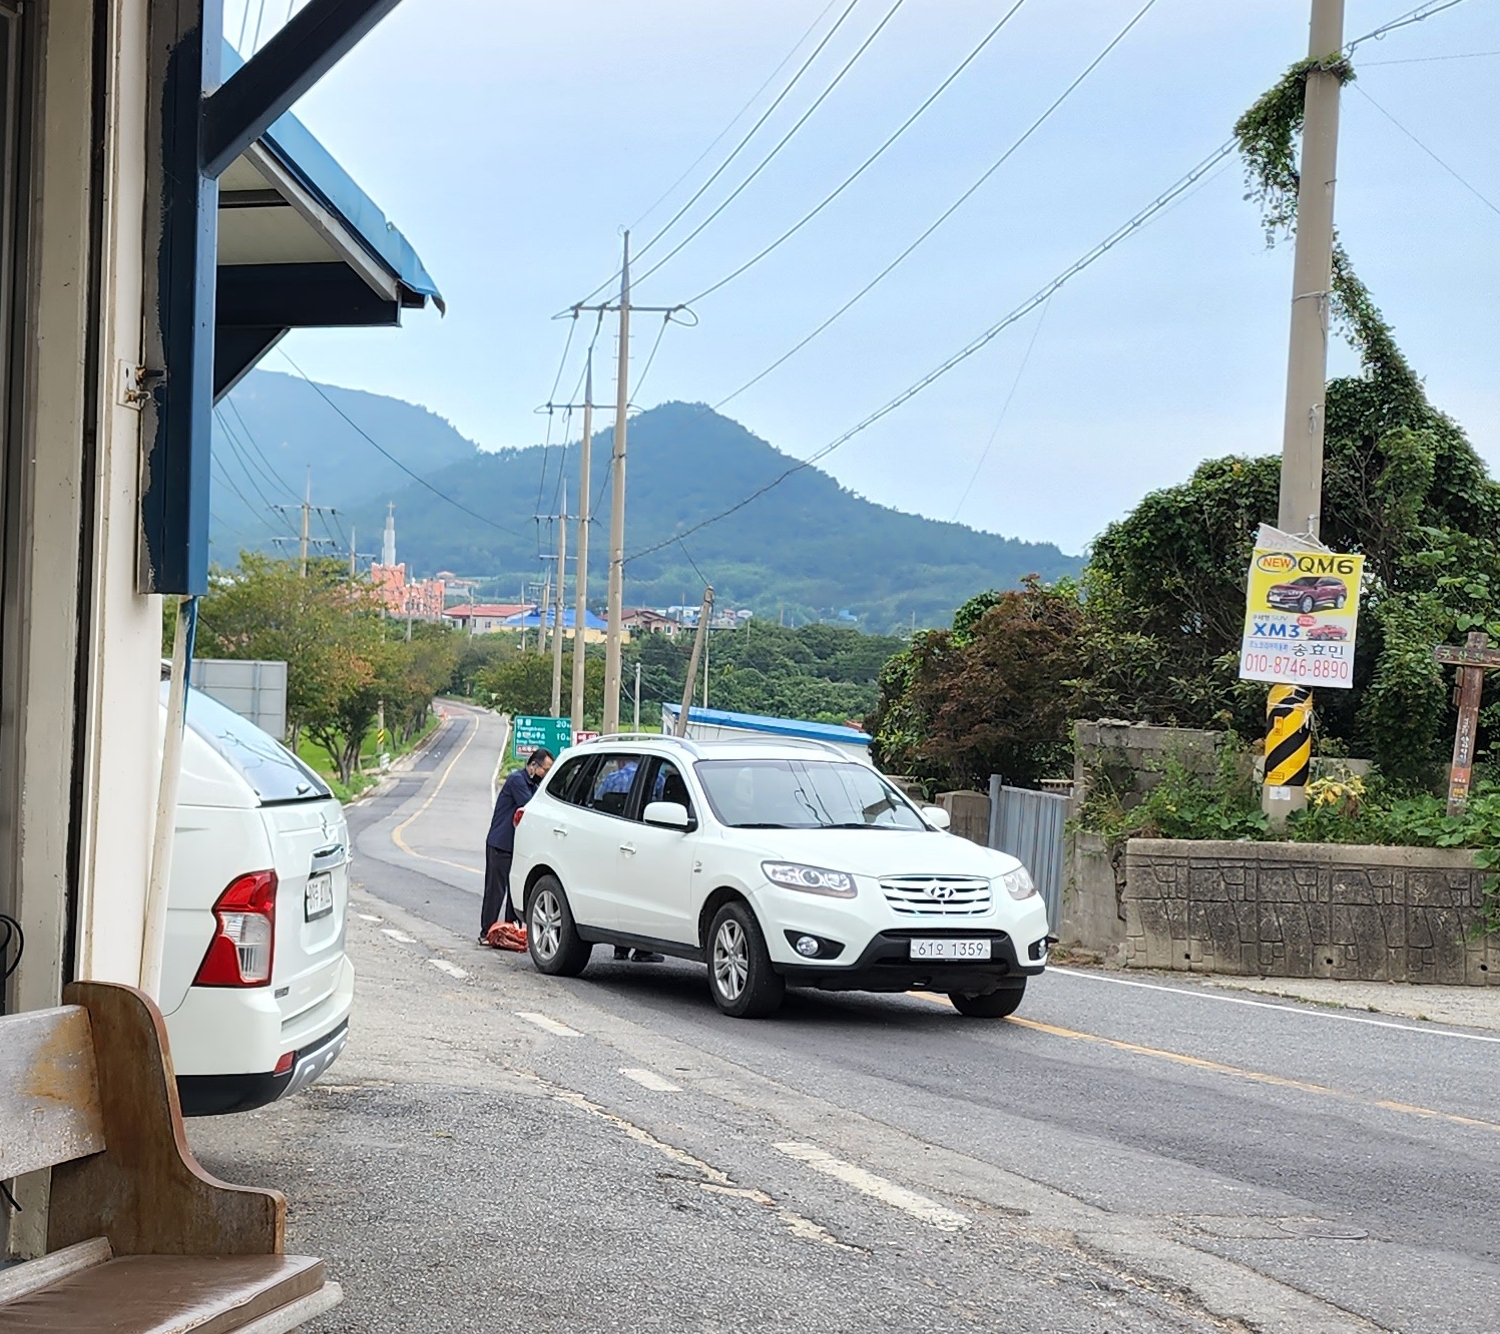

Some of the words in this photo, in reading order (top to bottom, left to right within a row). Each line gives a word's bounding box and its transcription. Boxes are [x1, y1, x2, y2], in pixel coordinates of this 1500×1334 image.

[1262, 557, 1292, 569] NEW
[1298, 556, 1355, 575] QM6
[1253, 622, 1300, 638] XM3
[1292, 644, 1344, 660] 송효민
[1245, 653, 1348, 679] 010-8746-8890
[556, 720, 567, 729] 20
[556, 732, 566, 741] 10
[918, 942, 944, 956] 61오
[952, 942, 984, 956] 1359
